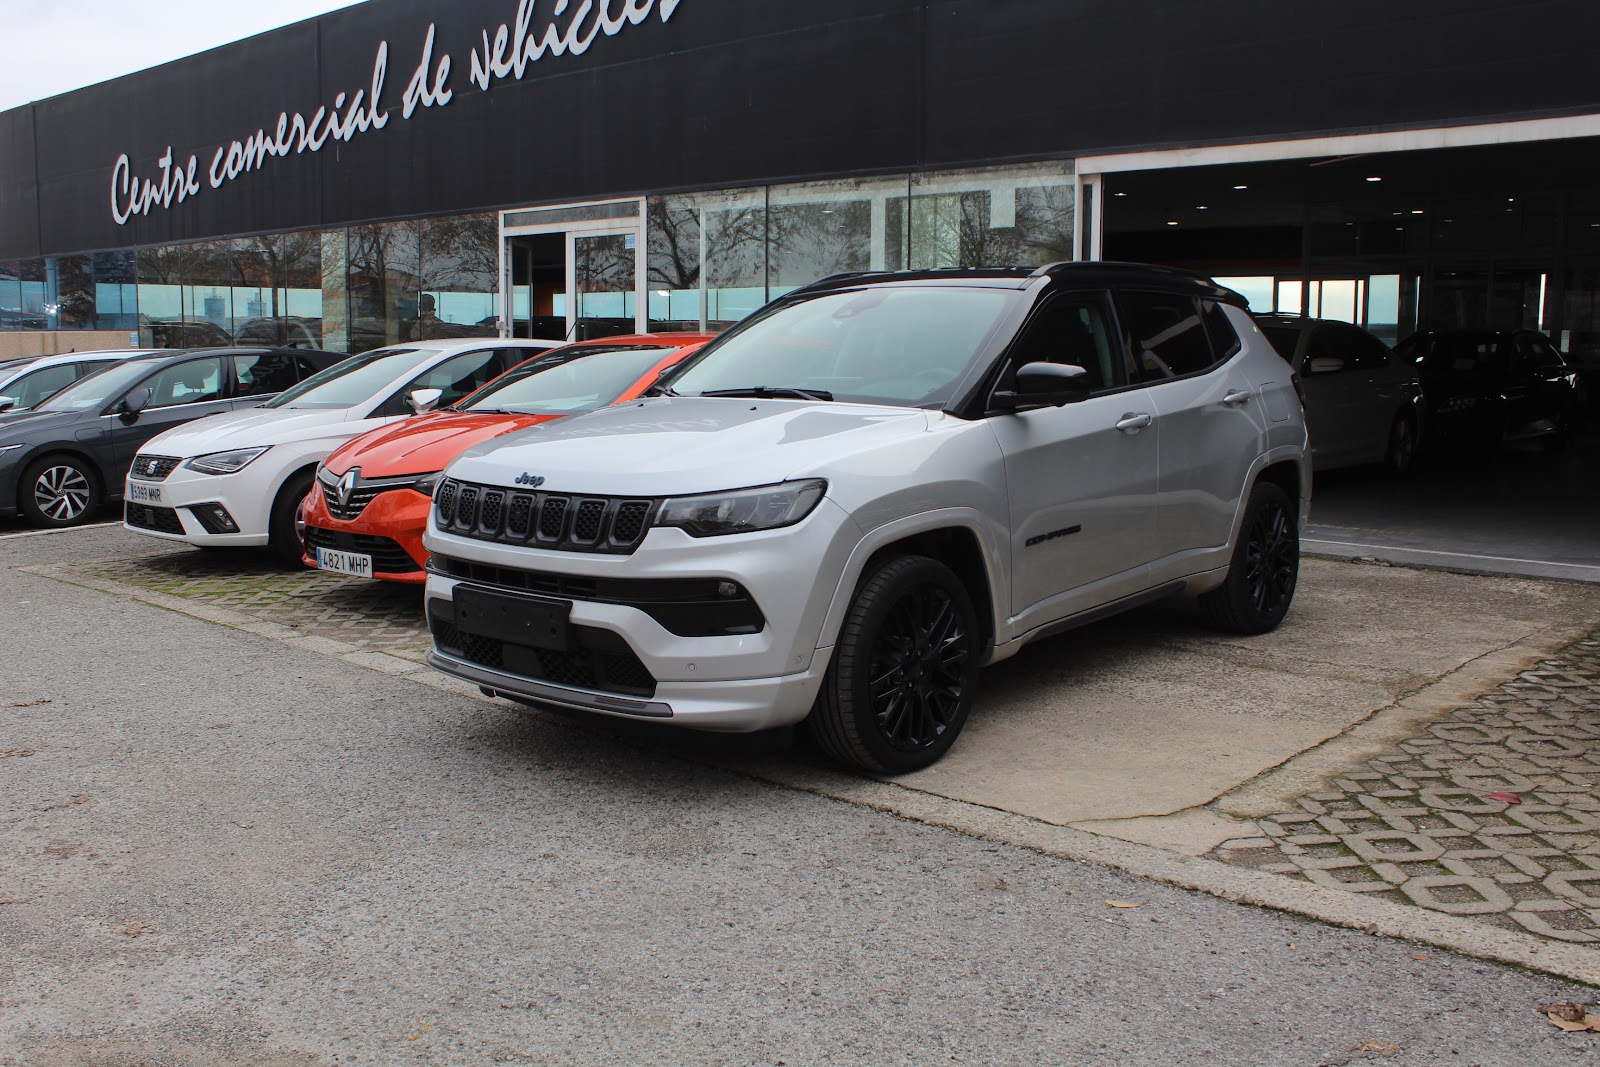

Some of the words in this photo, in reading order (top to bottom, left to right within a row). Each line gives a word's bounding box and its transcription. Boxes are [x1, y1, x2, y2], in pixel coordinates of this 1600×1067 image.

[111, 145, 200, 225] Centre
[209, 40, 389, 189] comercial
[402, 22, 453, 120] de
[514, 471, 546, 489] Jeep
[323, 551, 345, 571] 4821
[348, 555, 369, 574] MHP
